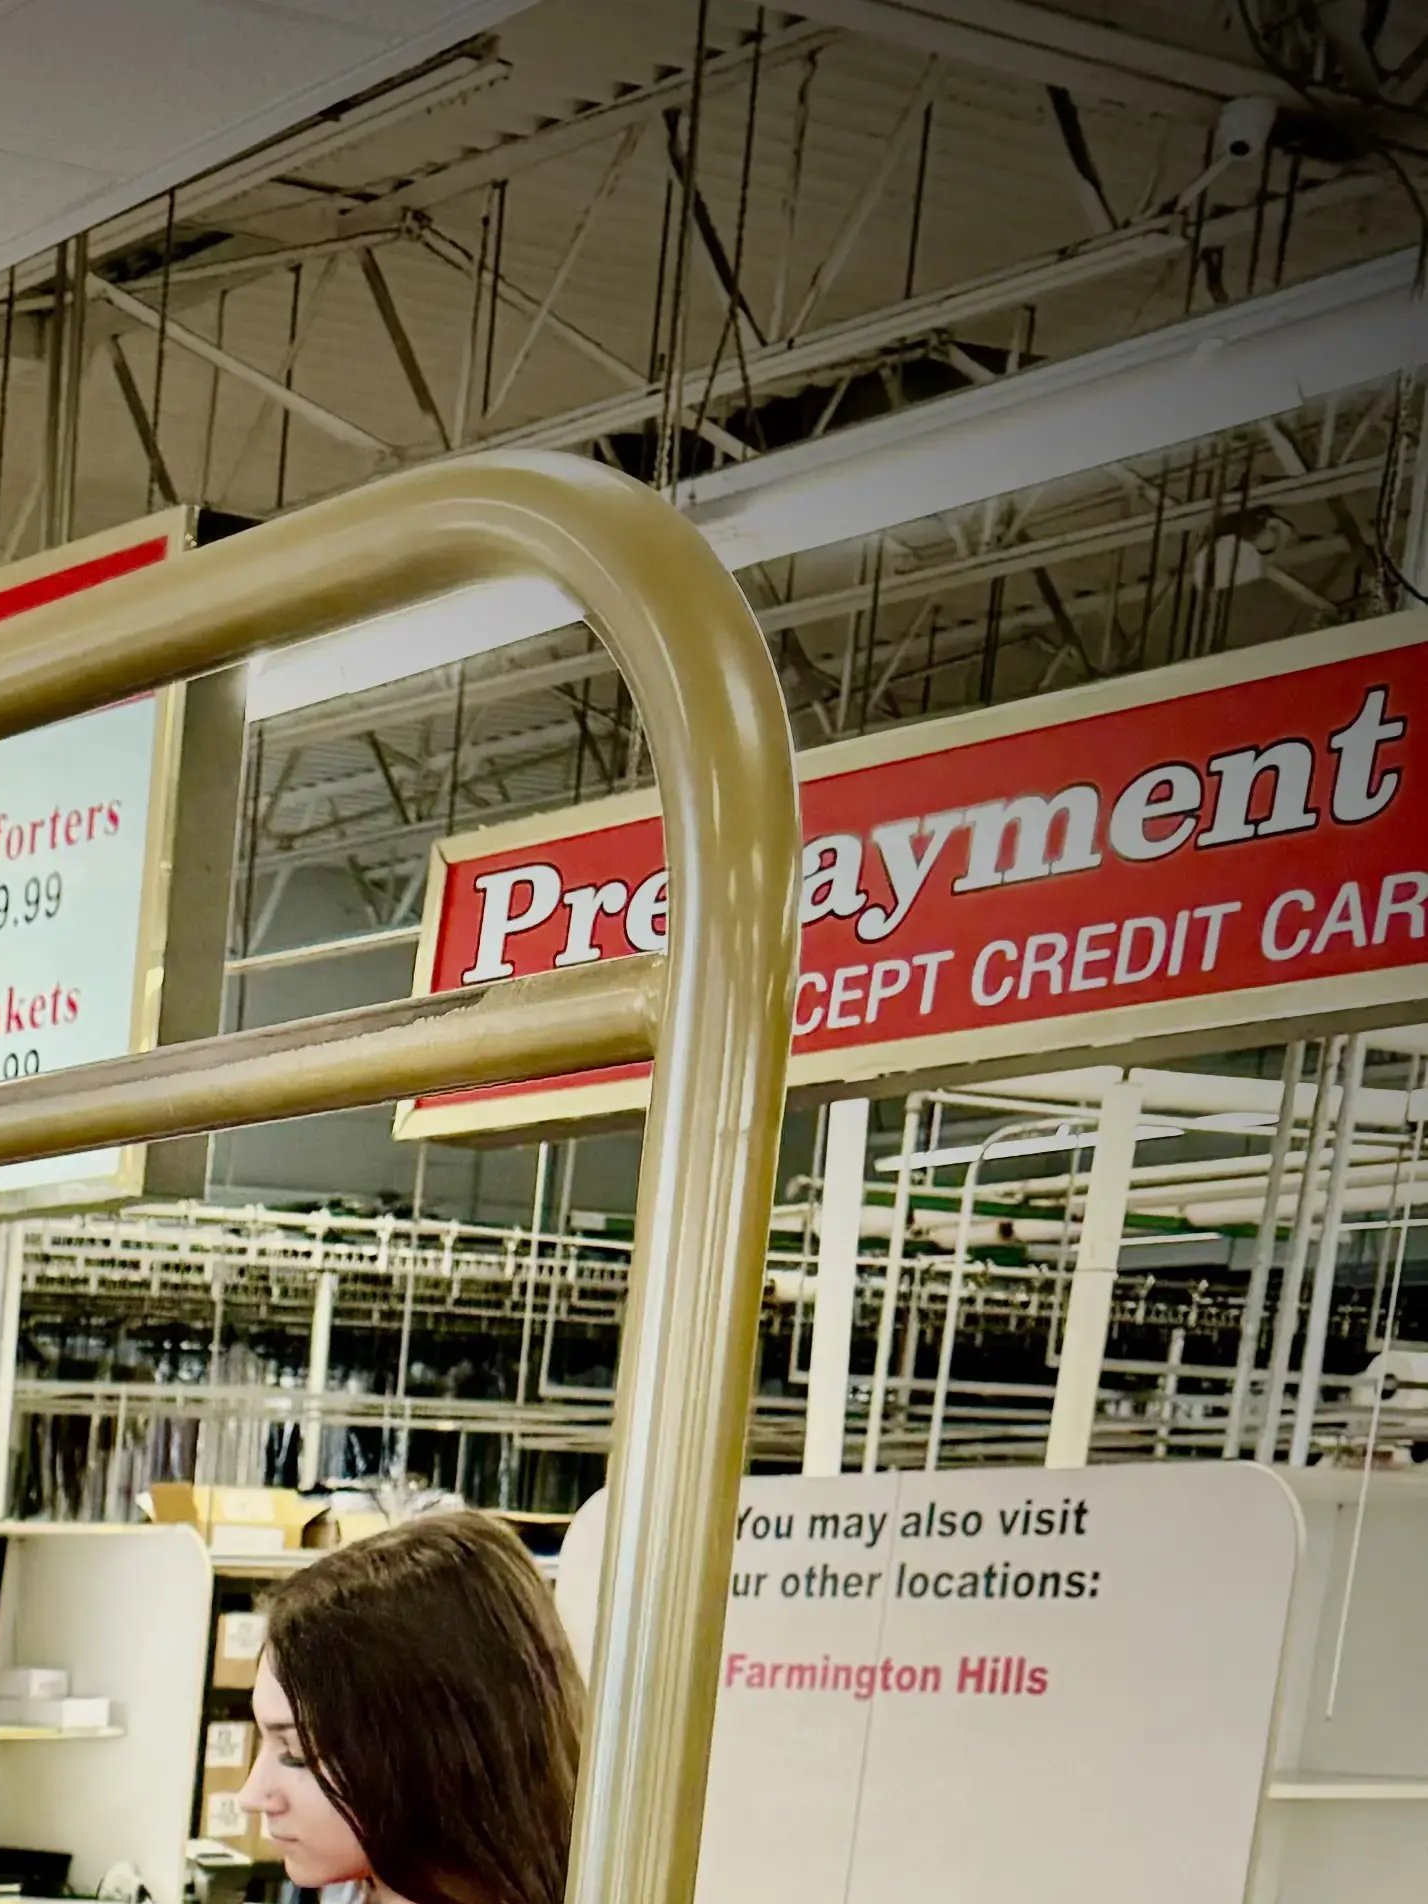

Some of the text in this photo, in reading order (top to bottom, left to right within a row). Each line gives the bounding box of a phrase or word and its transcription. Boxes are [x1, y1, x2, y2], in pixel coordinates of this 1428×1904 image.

[462, 685, 1406, 984] Preayment
[792, 950, 954, 1036] CEPT
[970, 900, 1241, 1007] CREDIT
[808, 1509, 887, 1549] may
[900, 1500, 983, 1537] also
[999, 1498, 1089, 1536] visit
[731, 1562, 1102, 1599] ur other locations:
[724, 1652, 1050, 1701] Farmington Hills
